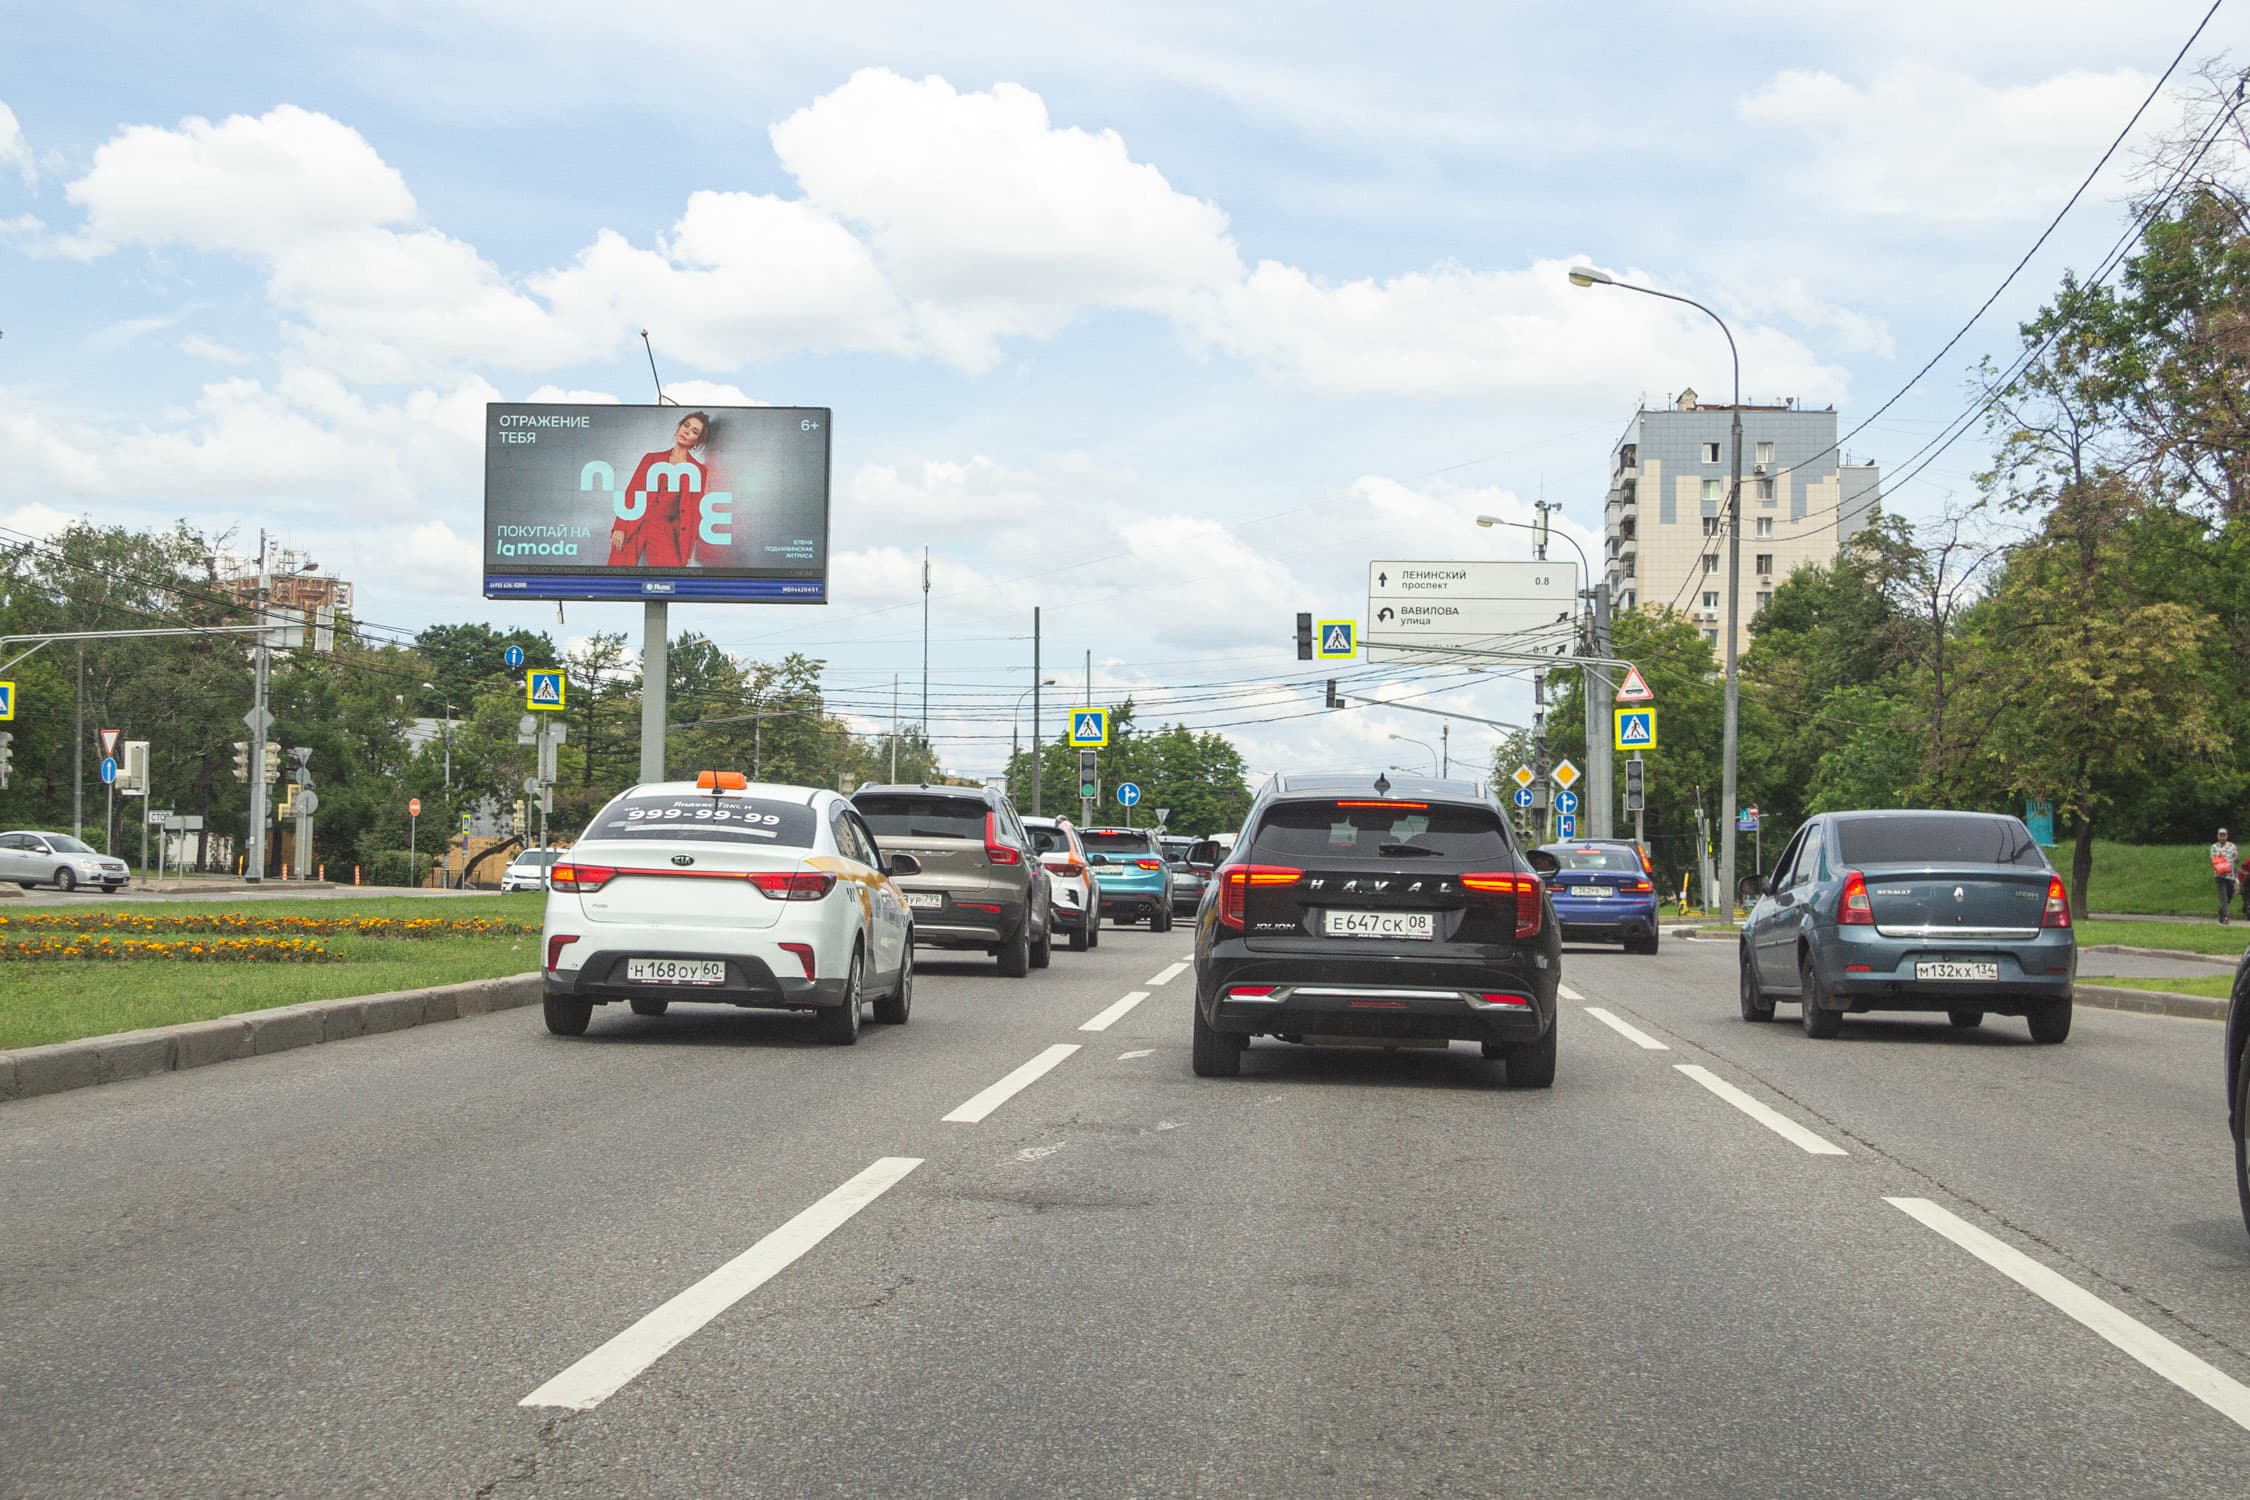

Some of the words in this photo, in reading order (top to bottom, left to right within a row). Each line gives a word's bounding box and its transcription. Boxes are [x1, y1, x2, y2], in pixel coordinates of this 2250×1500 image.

[499, 415, 590, 428] ОТРАЖЕНИЕ
[800, 419, 820, 431] 6+
[499, 431, 536, 444] ТЕБЯ
[497, 524, 567, 537] ПОКУПАЙ
[570, 527, 591, 538] НА
[496, 539, 578, 557] lamoda
[1401, 569, 1467, 581] ЛЕНИНСКИЙ
[1534, 576, 1550, 586] 0.8
[1401, 581, 1448, 591] проспект
[1400, 606, 1460, 617] ВАВИЛОВА
[1400, 617, 1432, 627] улица
[628, 808, 781, 826] 999-99-99
[672, 855, 692, 866] KIA
[1309, 879, 1452, 893] HAVAL
[1253, 922, 1296, 931] JOLION
[1408, 916, 1426, 929] 08
